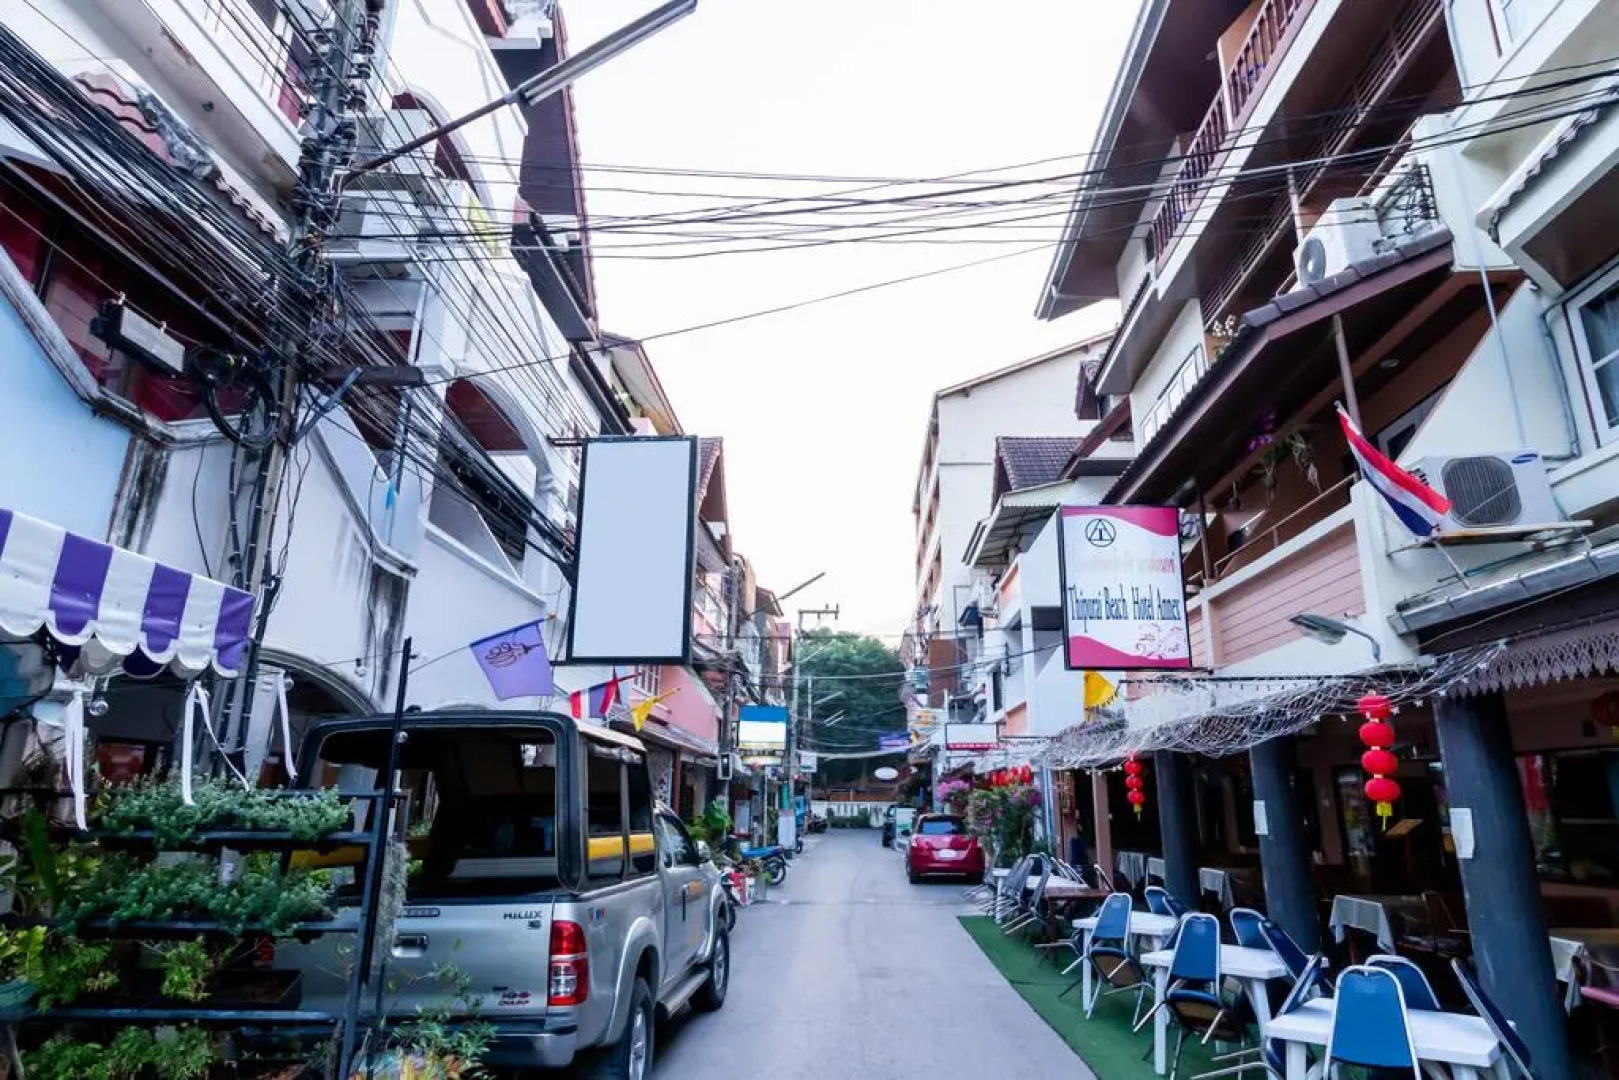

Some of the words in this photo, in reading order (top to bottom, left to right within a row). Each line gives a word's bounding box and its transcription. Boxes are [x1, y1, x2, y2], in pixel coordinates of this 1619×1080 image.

[1103, 582, 1129, 620] Beach
[1131, 583, 1154, 620] Hotel
[1157, 586, 1181, 620] Annex
